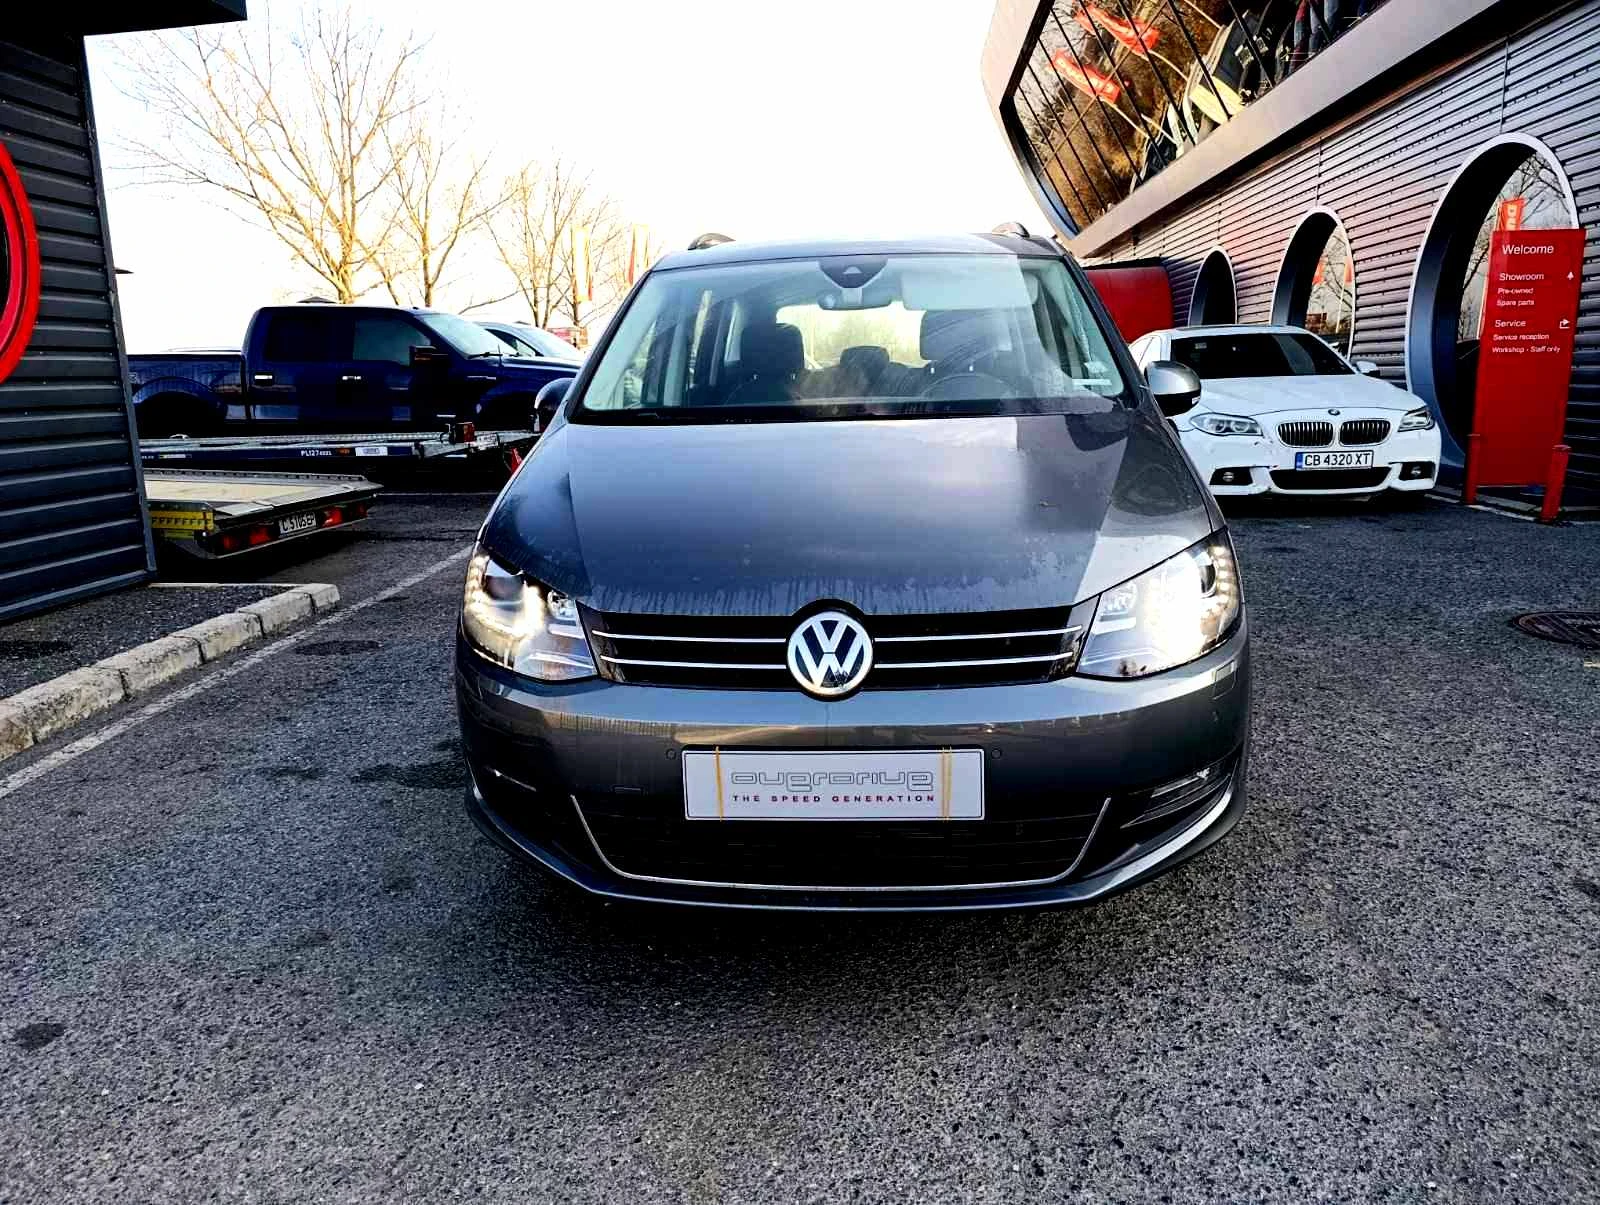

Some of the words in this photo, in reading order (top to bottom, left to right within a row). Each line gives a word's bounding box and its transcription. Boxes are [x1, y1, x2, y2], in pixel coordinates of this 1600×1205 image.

[1502, 244, 1554, 255] Welcome
[1499, 272, 1545, 281] Showroom
[1497, 287, 1534, 295] Pre-owned
[1496, 299, 1517, 307] Spare
[1517, 299, 1535, 307] parts
[1494, 319, 1527, 328] Service
[1519, 333, 1550, 341] reception
[1491, 346, 1525, 354] Workshop
[1530, 345, 1546, 353] Staff
[1546, 346, 1561, 354] only
[1304, 454, 1321, 466] CB
[1323, 453, 1353, 465] 4320
[1355, 452, 1371, 465] XT
[732, 794, 761, 802] THE
[771, 794, 822, 803] SPEED
[831, 794, 936, 803] GENERATION
